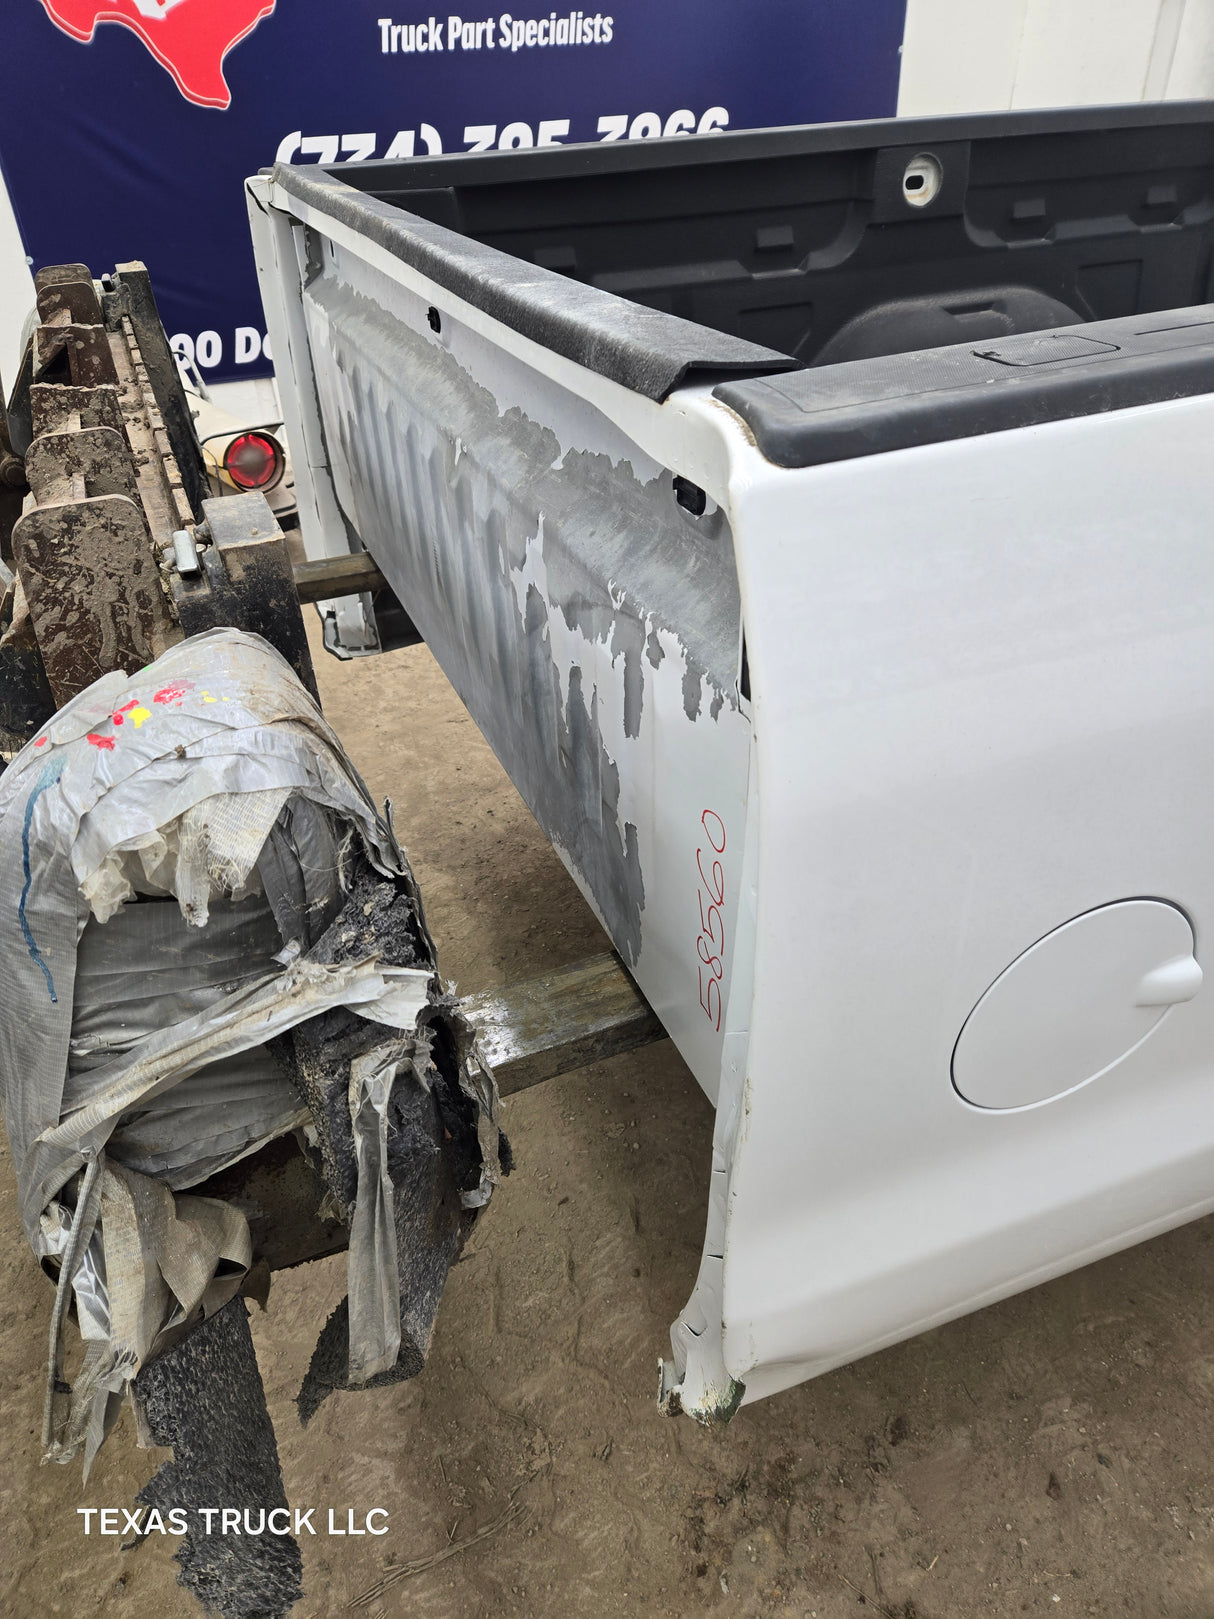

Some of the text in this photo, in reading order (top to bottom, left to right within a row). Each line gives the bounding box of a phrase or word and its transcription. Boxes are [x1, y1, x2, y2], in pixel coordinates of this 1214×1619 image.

[377, 11, 614, 53] Truck Part Specialists
[697, 809, 726, 1032] 58560
